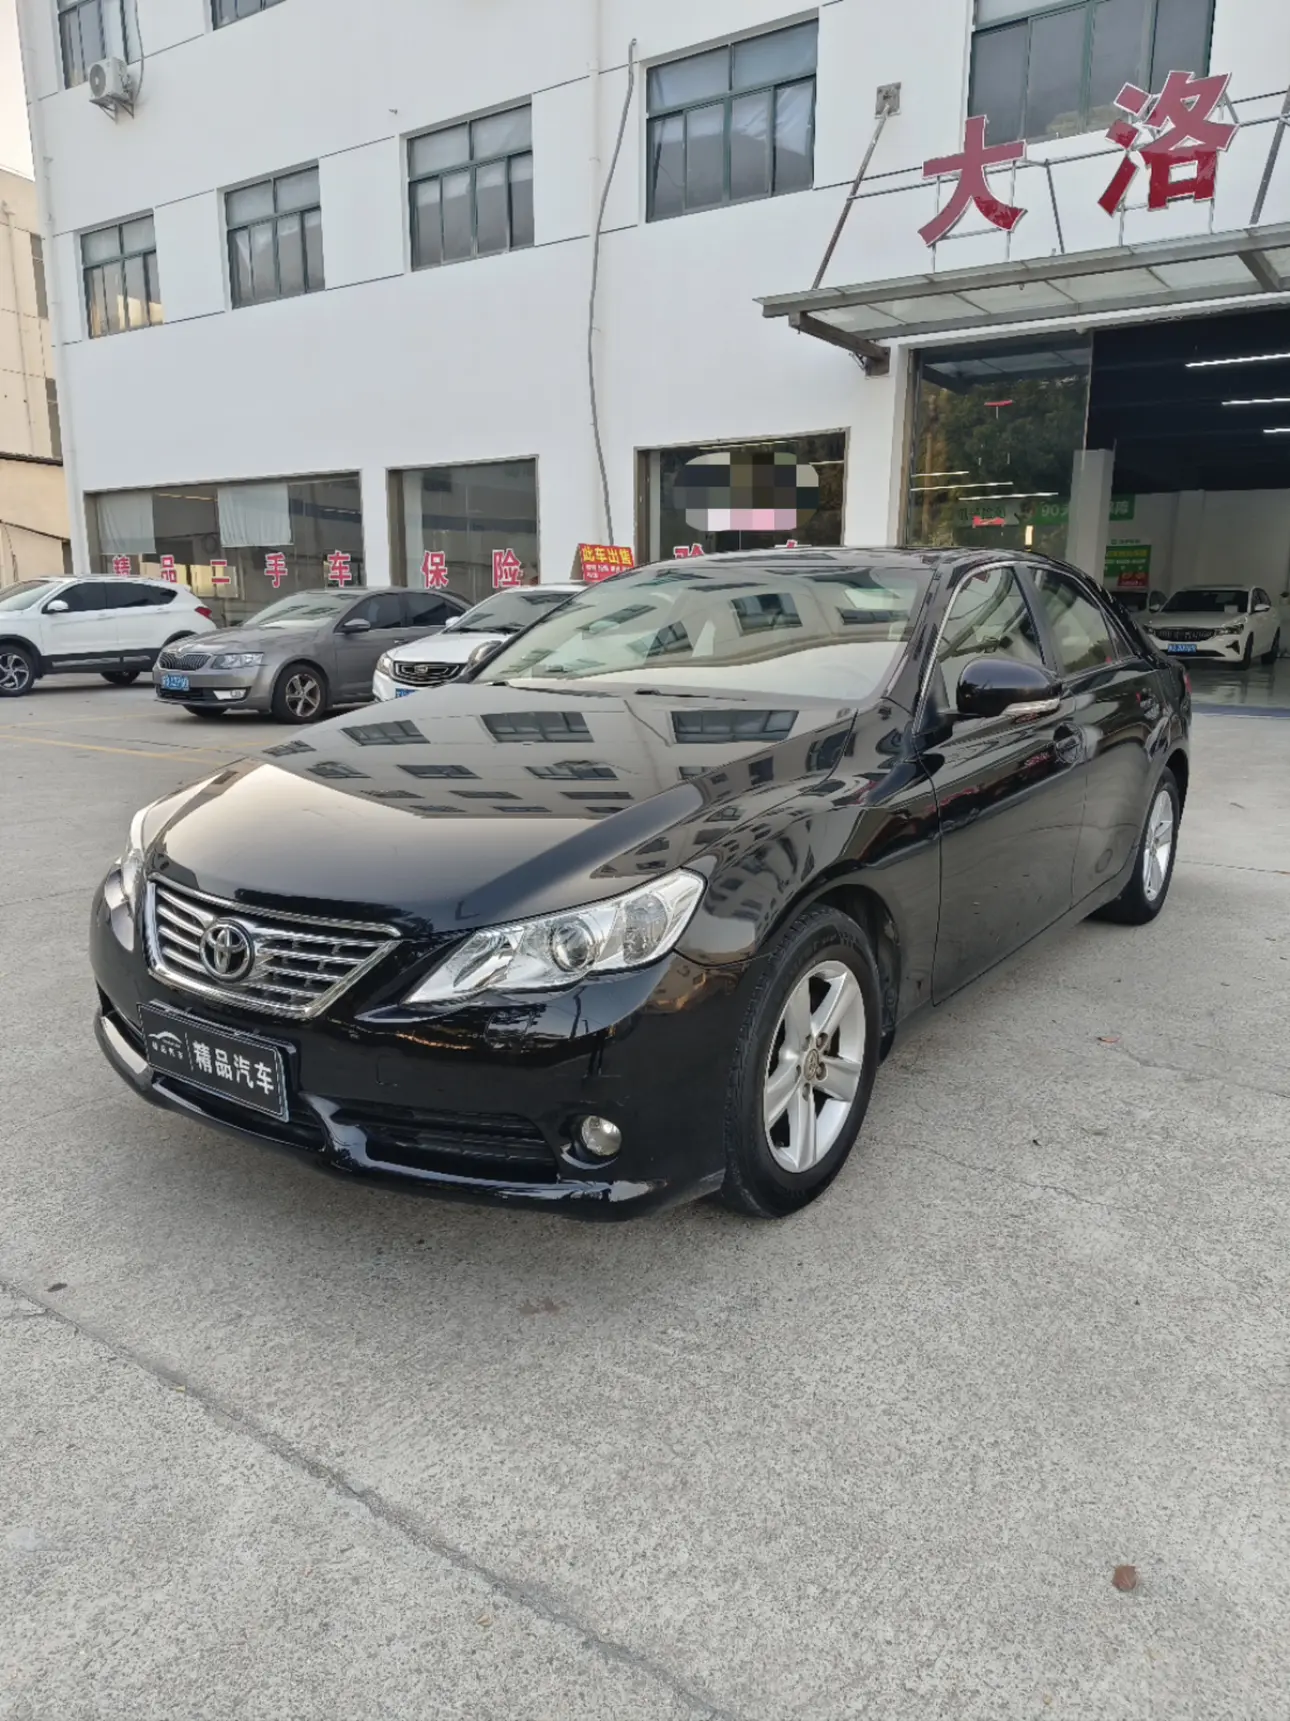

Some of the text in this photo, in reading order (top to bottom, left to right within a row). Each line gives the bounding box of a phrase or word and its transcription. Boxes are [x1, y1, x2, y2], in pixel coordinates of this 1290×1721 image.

[917, 70, 1239, 247] 大洛
[112, 550, 352, 588] 精品二手车
[420, 548, 522, 589] 保险
[193, 1041, 274, 1094] 精品汽车
